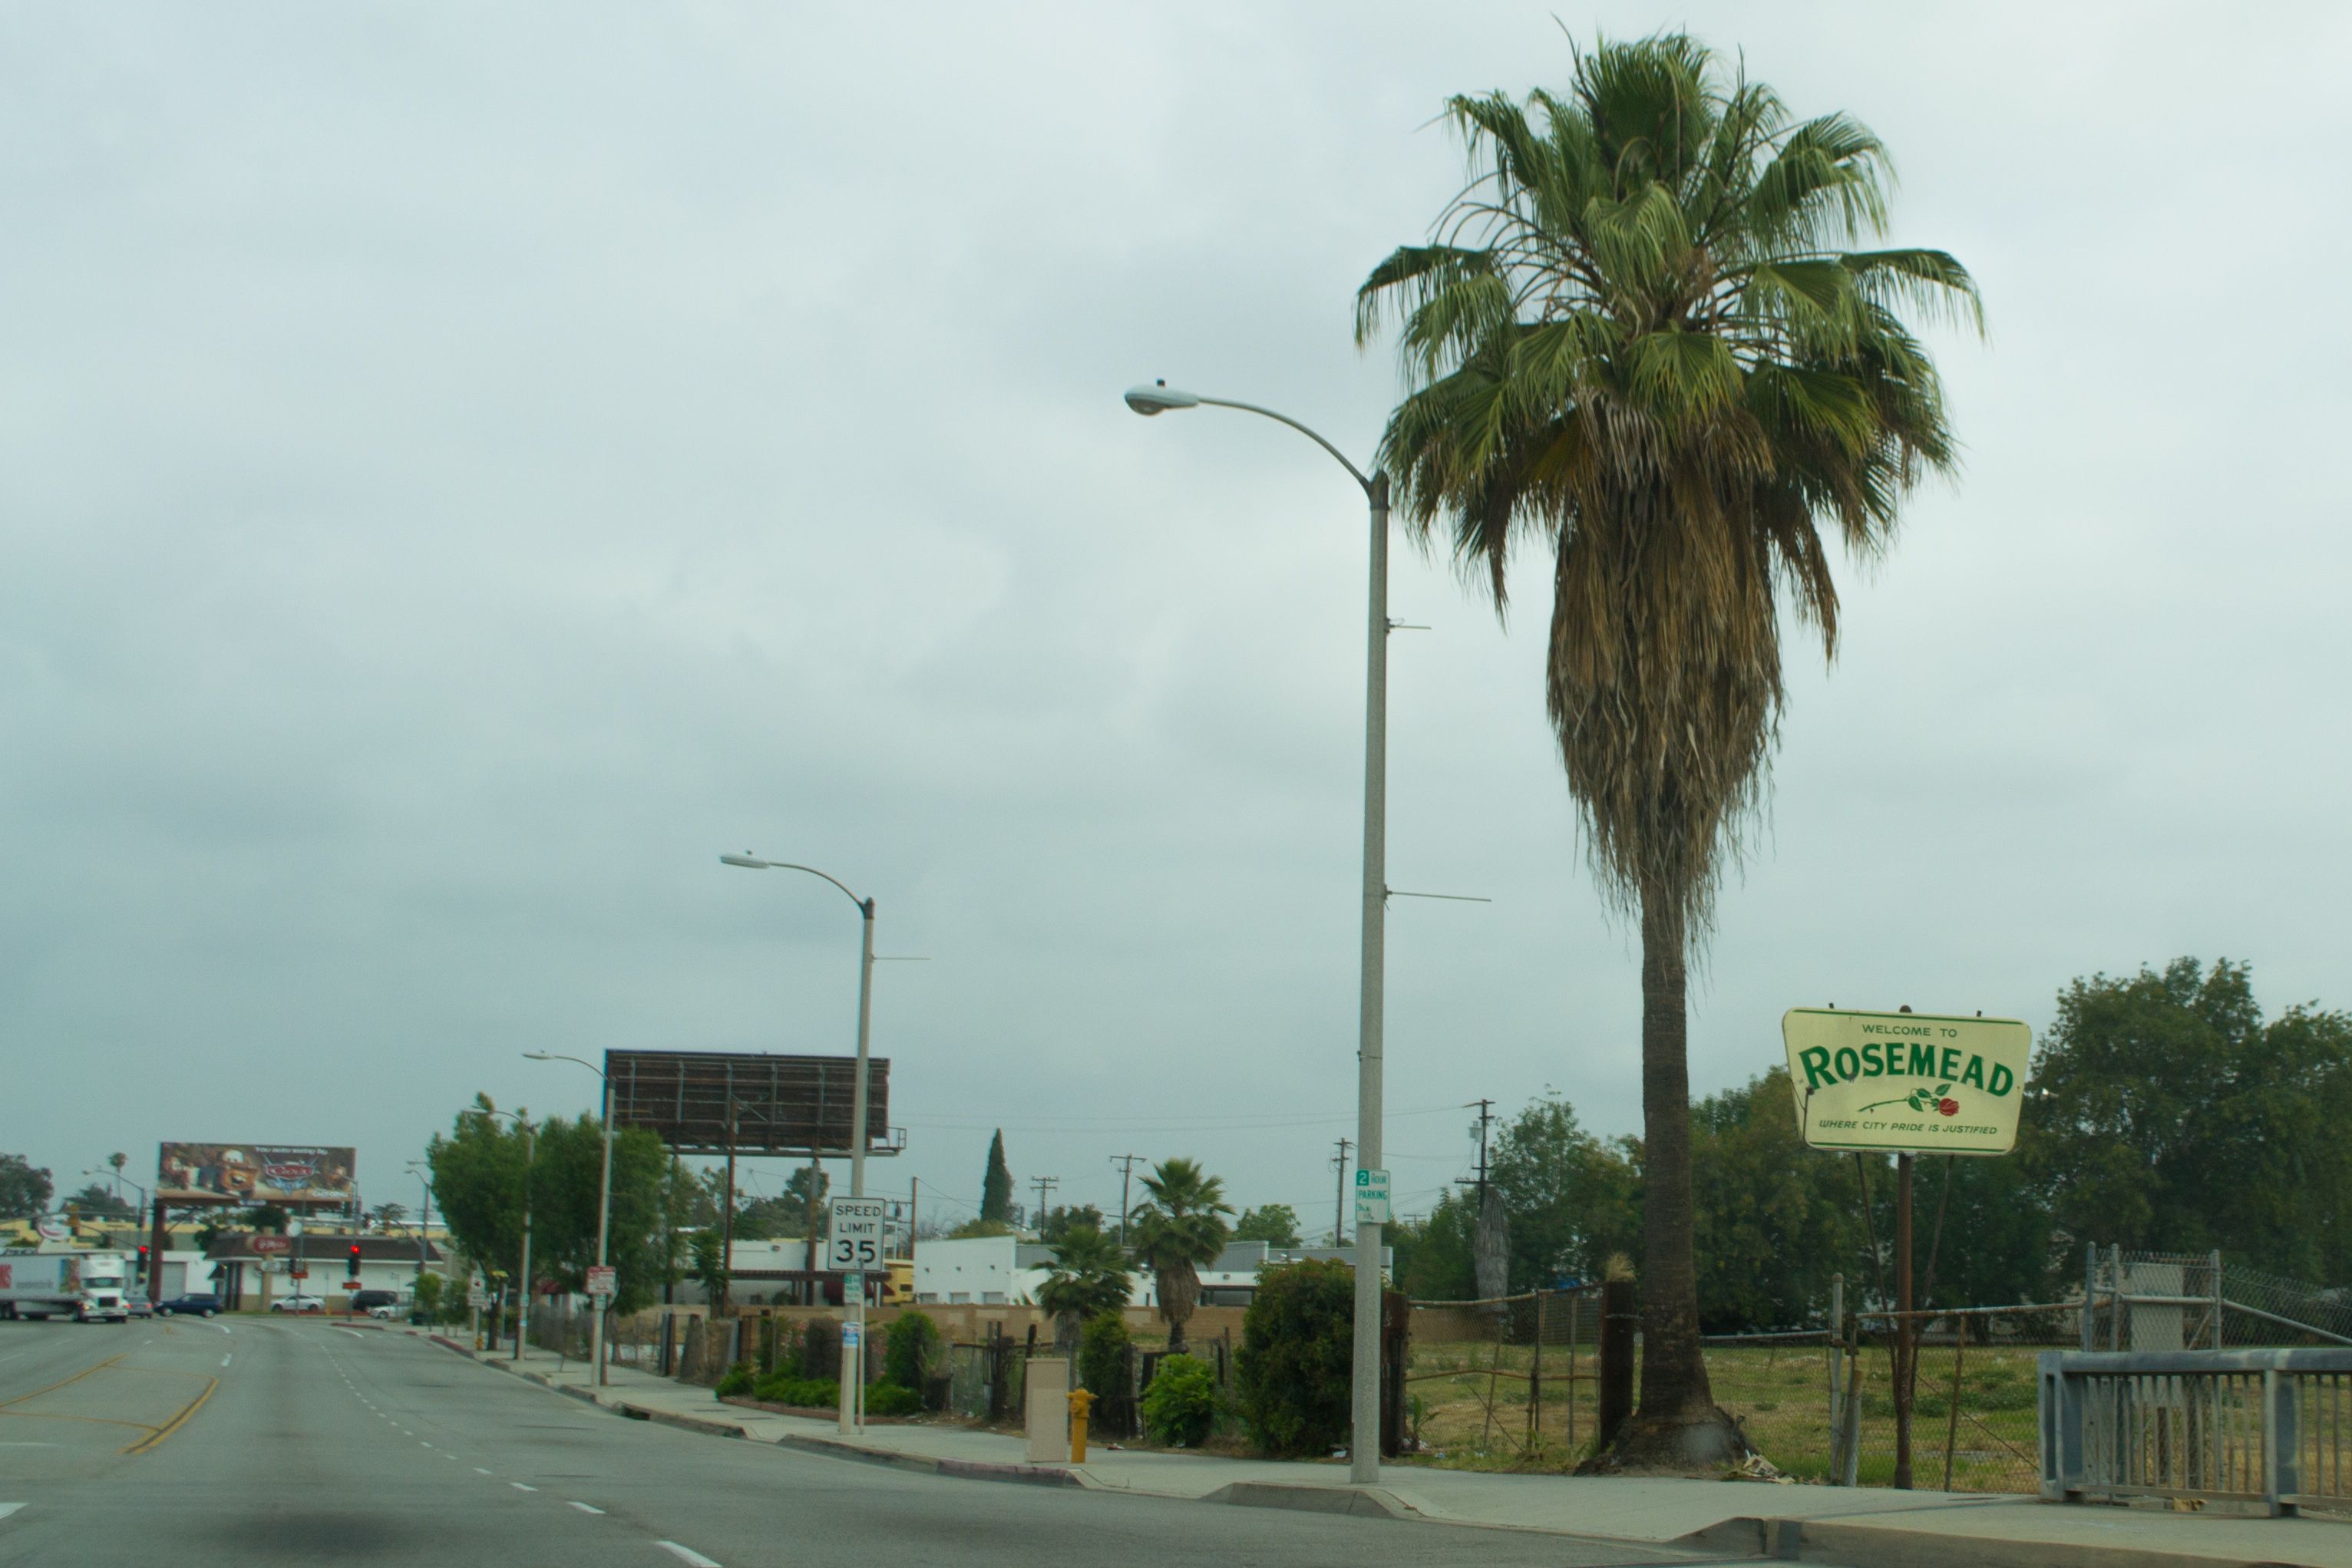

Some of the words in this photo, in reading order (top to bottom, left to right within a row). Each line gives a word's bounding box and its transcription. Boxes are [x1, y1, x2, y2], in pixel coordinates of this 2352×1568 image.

[1861, 1024, 1931, 1036] WELCOME
[1939, 1028, 1957, 1038] TO
[1799, 1042, 2013, 1098] ROSEMEAD
[1819, 1120, 1857, 1129] WHERE
[1862, 1121, 1887, 1131] CITY
[1891, 1123, 1924, 1132] PRIDE
[1928, 1124, 1940, 1133] IS
[1942, 1125, 1998, 1135] JUSTIFIED
[1371, 1175, 1387, 1183] HOUR
[1359, 1190, 1387, 1200] PARKING
[835, 1204, 882, 1217] SPEED
[839, 1223, 876, 1234] LIMIT
[835, 1239, 877, 1264] 35
